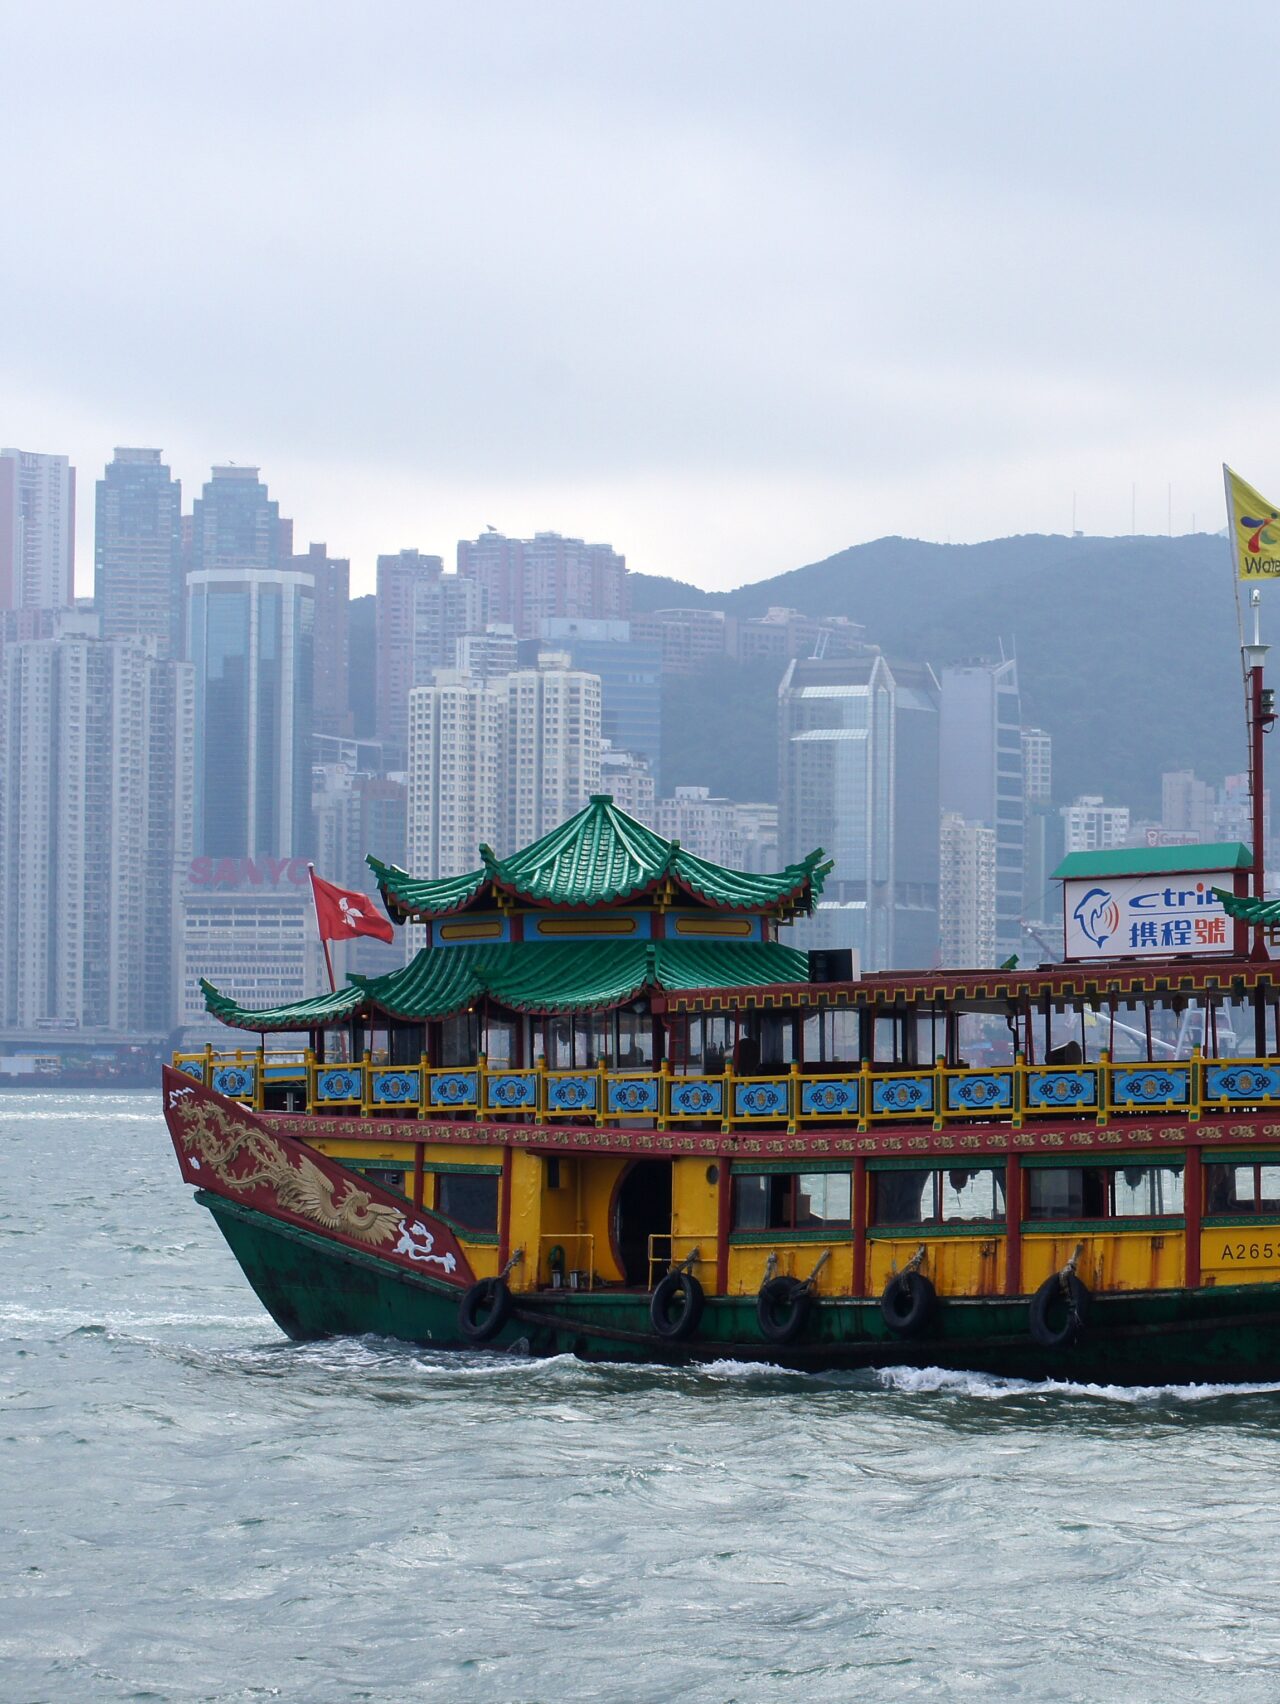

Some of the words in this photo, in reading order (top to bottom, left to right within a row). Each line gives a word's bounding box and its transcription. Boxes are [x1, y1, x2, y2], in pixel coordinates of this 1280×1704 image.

[1161, 833, 1199, 845] Garden
[188, 856, 310, 886] SANYO
[1129, 917, 1226, 948] 携程號
